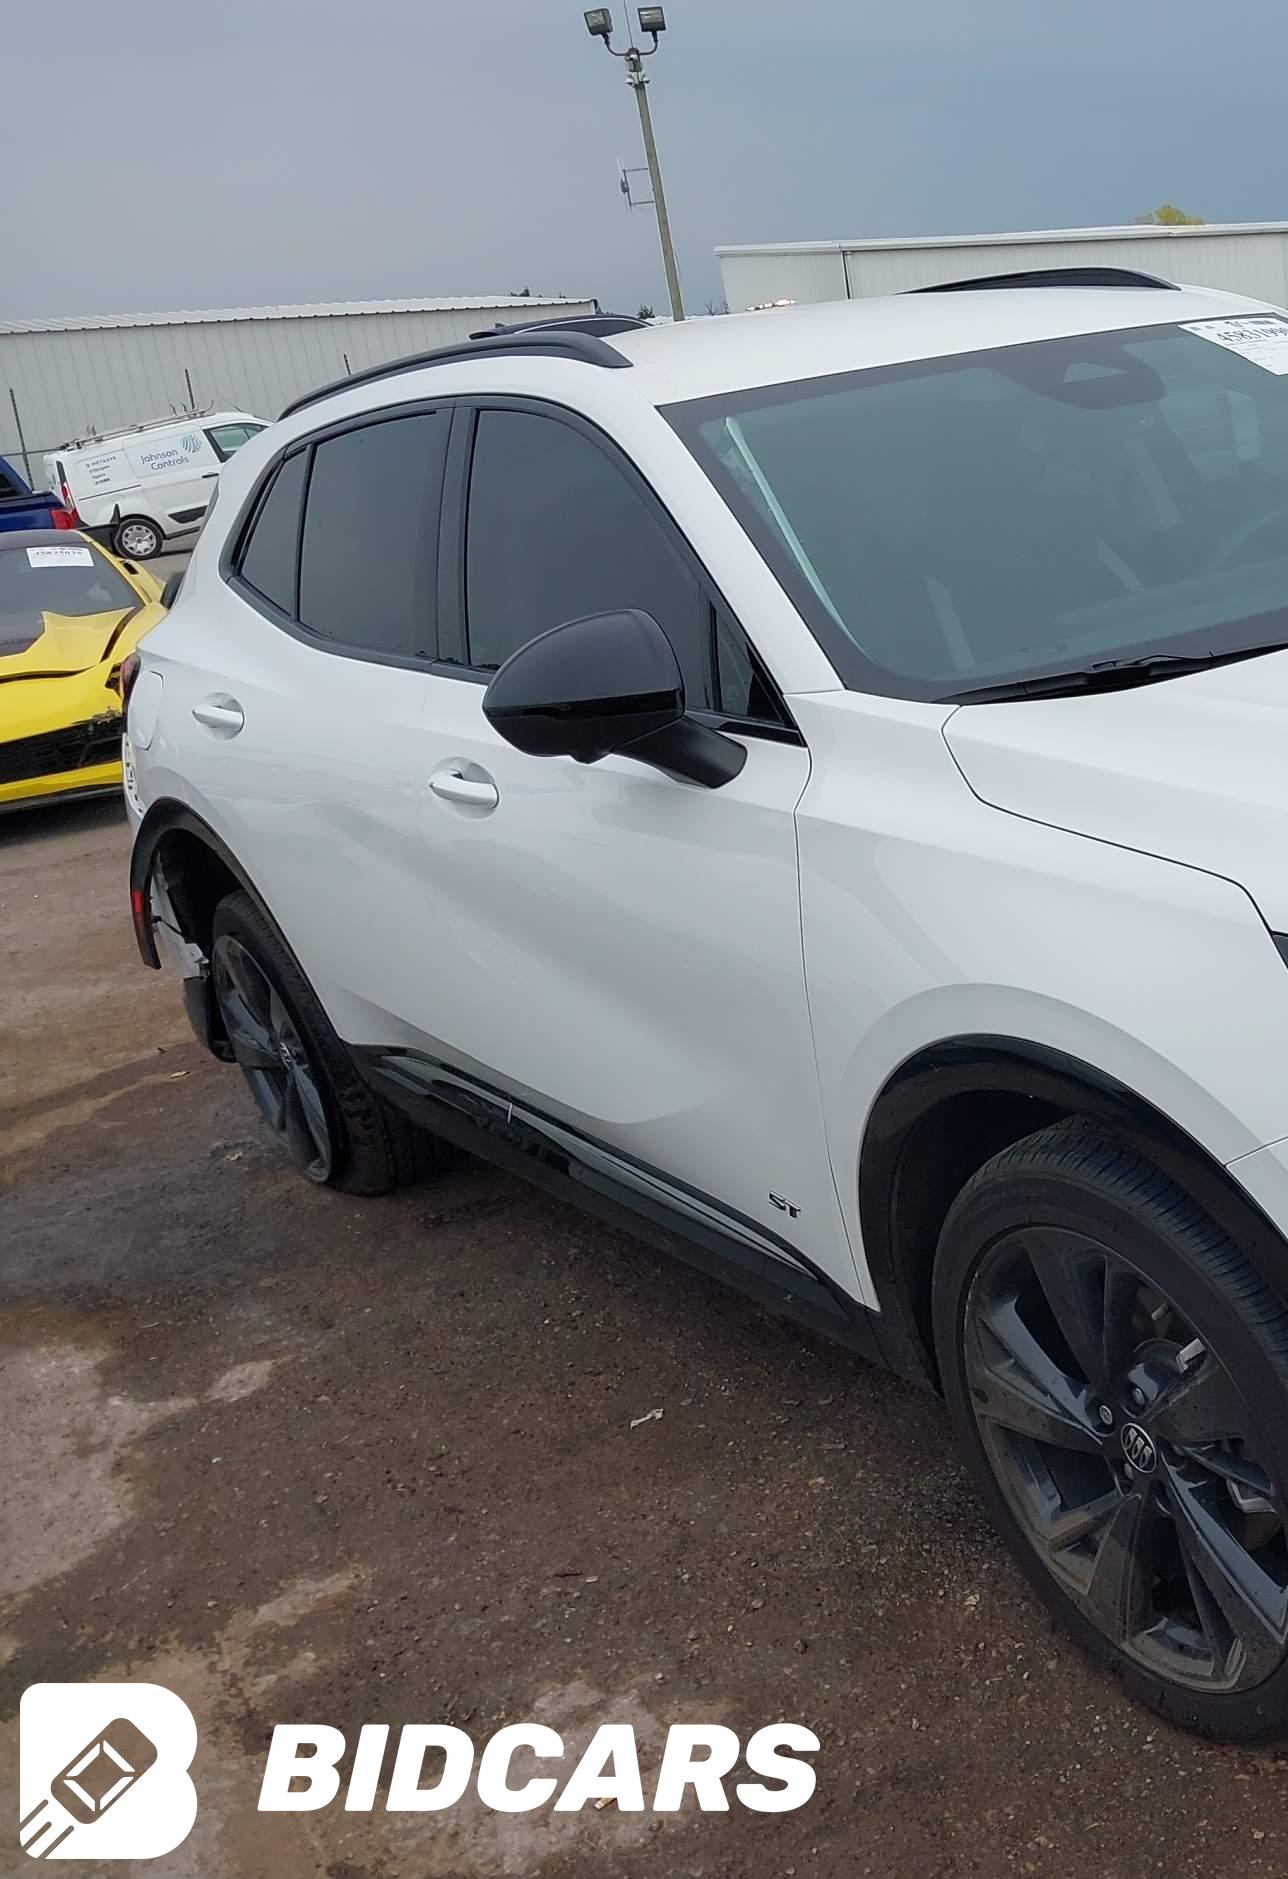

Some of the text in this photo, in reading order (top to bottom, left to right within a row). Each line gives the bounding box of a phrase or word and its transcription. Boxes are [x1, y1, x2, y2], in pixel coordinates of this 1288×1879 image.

[140, 449, 178, 464] Johnson
[150, 456, 189, 470] Controls
[768, 1190, 802, 1219] ST
